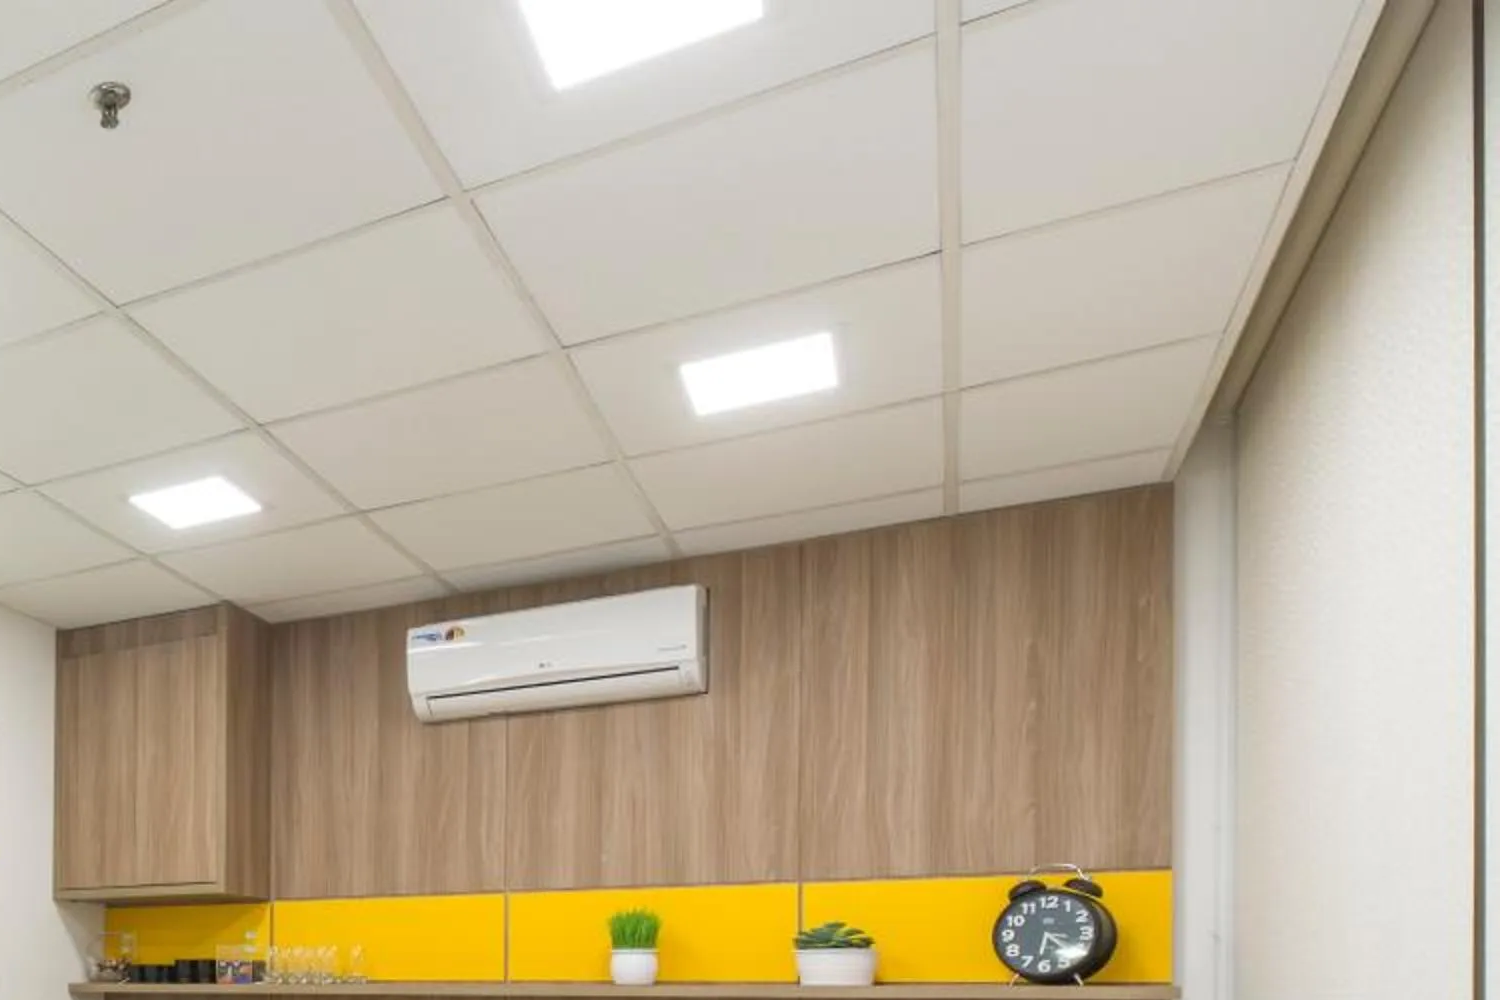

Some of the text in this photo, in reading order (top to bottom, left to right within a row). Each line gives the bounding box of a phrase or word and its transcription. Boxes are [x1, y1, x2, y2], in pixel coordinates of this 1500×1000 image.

[1020, 902, 1036, 914] 11
[1039, 895, 1059, 909] 12
[1063, 900, 1071, 912] 1
[1006, 915, 1025, 927] 10
[1076, 909, 1089, 923] 2
[1001, 929, 1015, 943] 9
[1080, 926, 1094, 940] 3
[1005, 944, 1020, 957] 8
[1020, 955, 1033, 968] 7
[1037, 960, 1051, 973] 6
